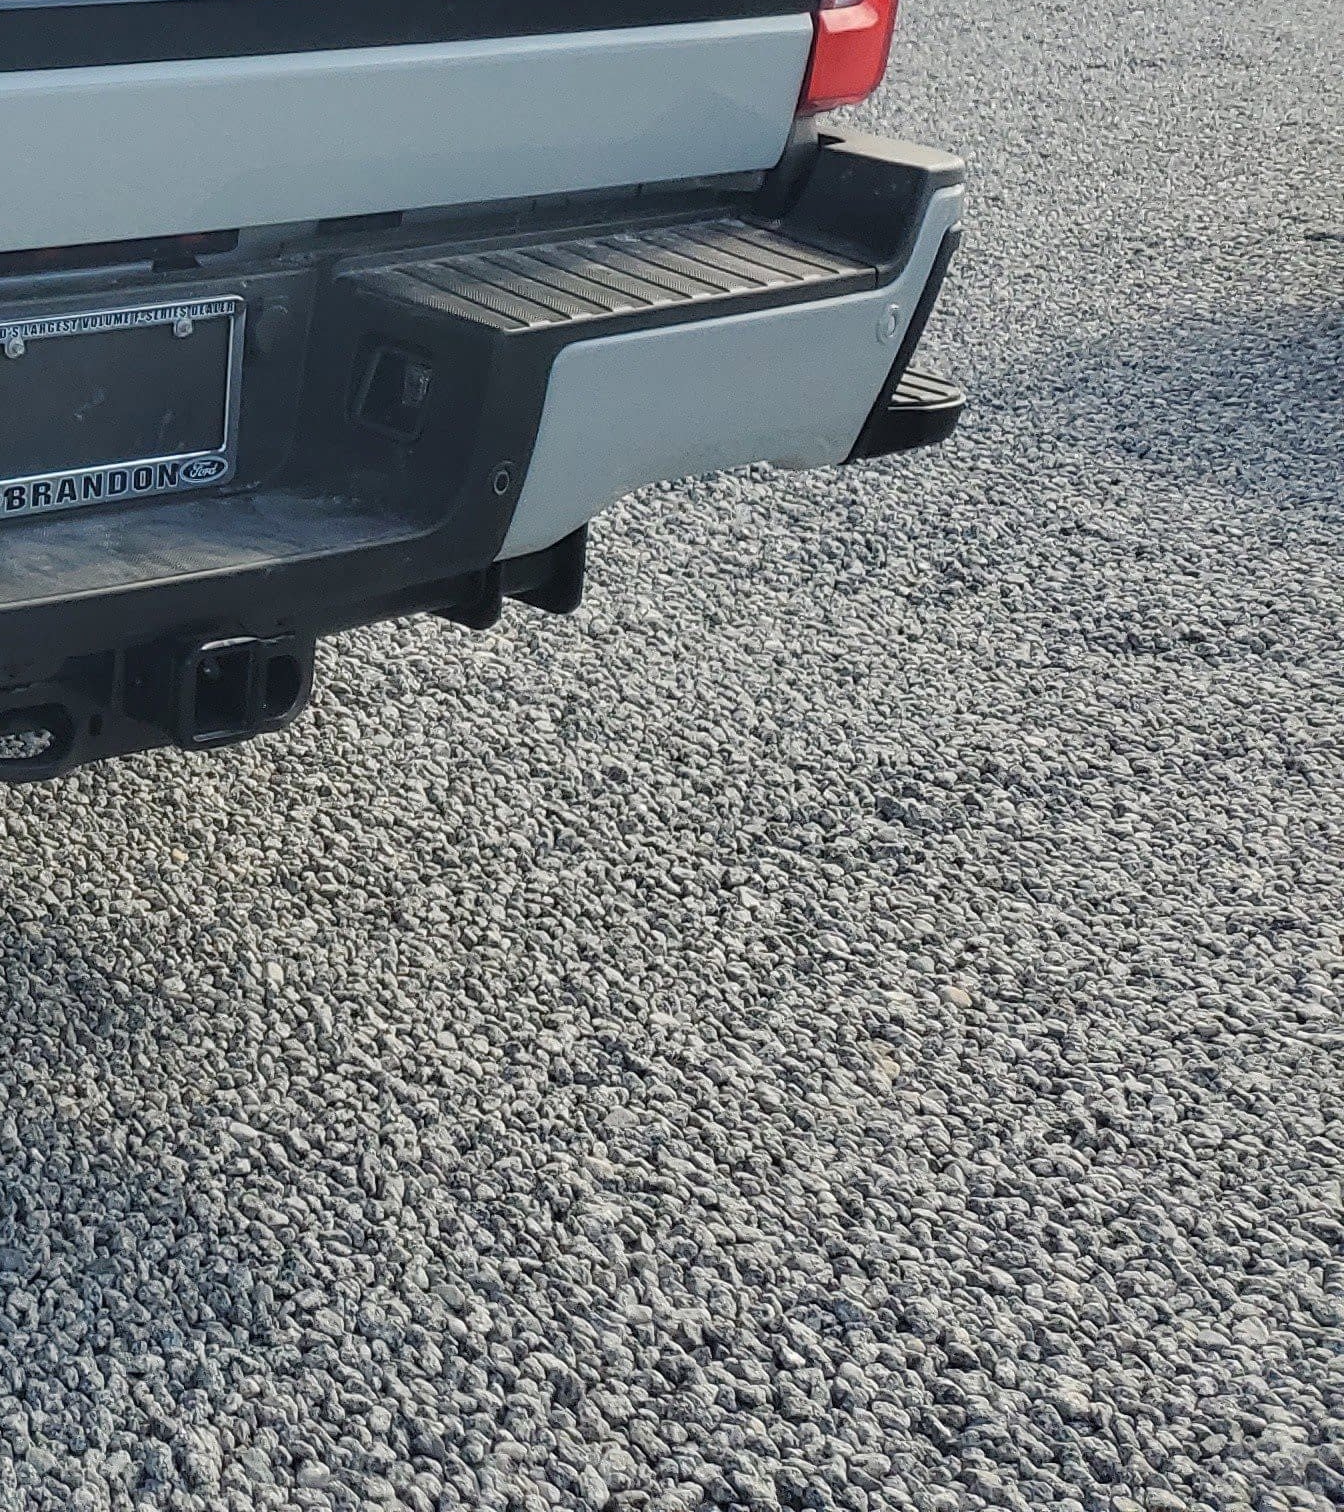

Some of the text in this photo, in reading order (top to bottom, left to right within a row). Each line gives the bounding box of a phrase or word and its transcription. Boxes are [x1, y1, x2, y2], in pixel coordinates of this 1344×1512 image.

[23, 319, 78, 336] LARGEST
[81, 313, 130, 329] VOLUME
[134, 307, 187, 323] F-SERIES
[191, 301, 235, 316] DEALER
[4, 462, 182, 511] BRANDON
[189, 460, 217, 478] Ford
